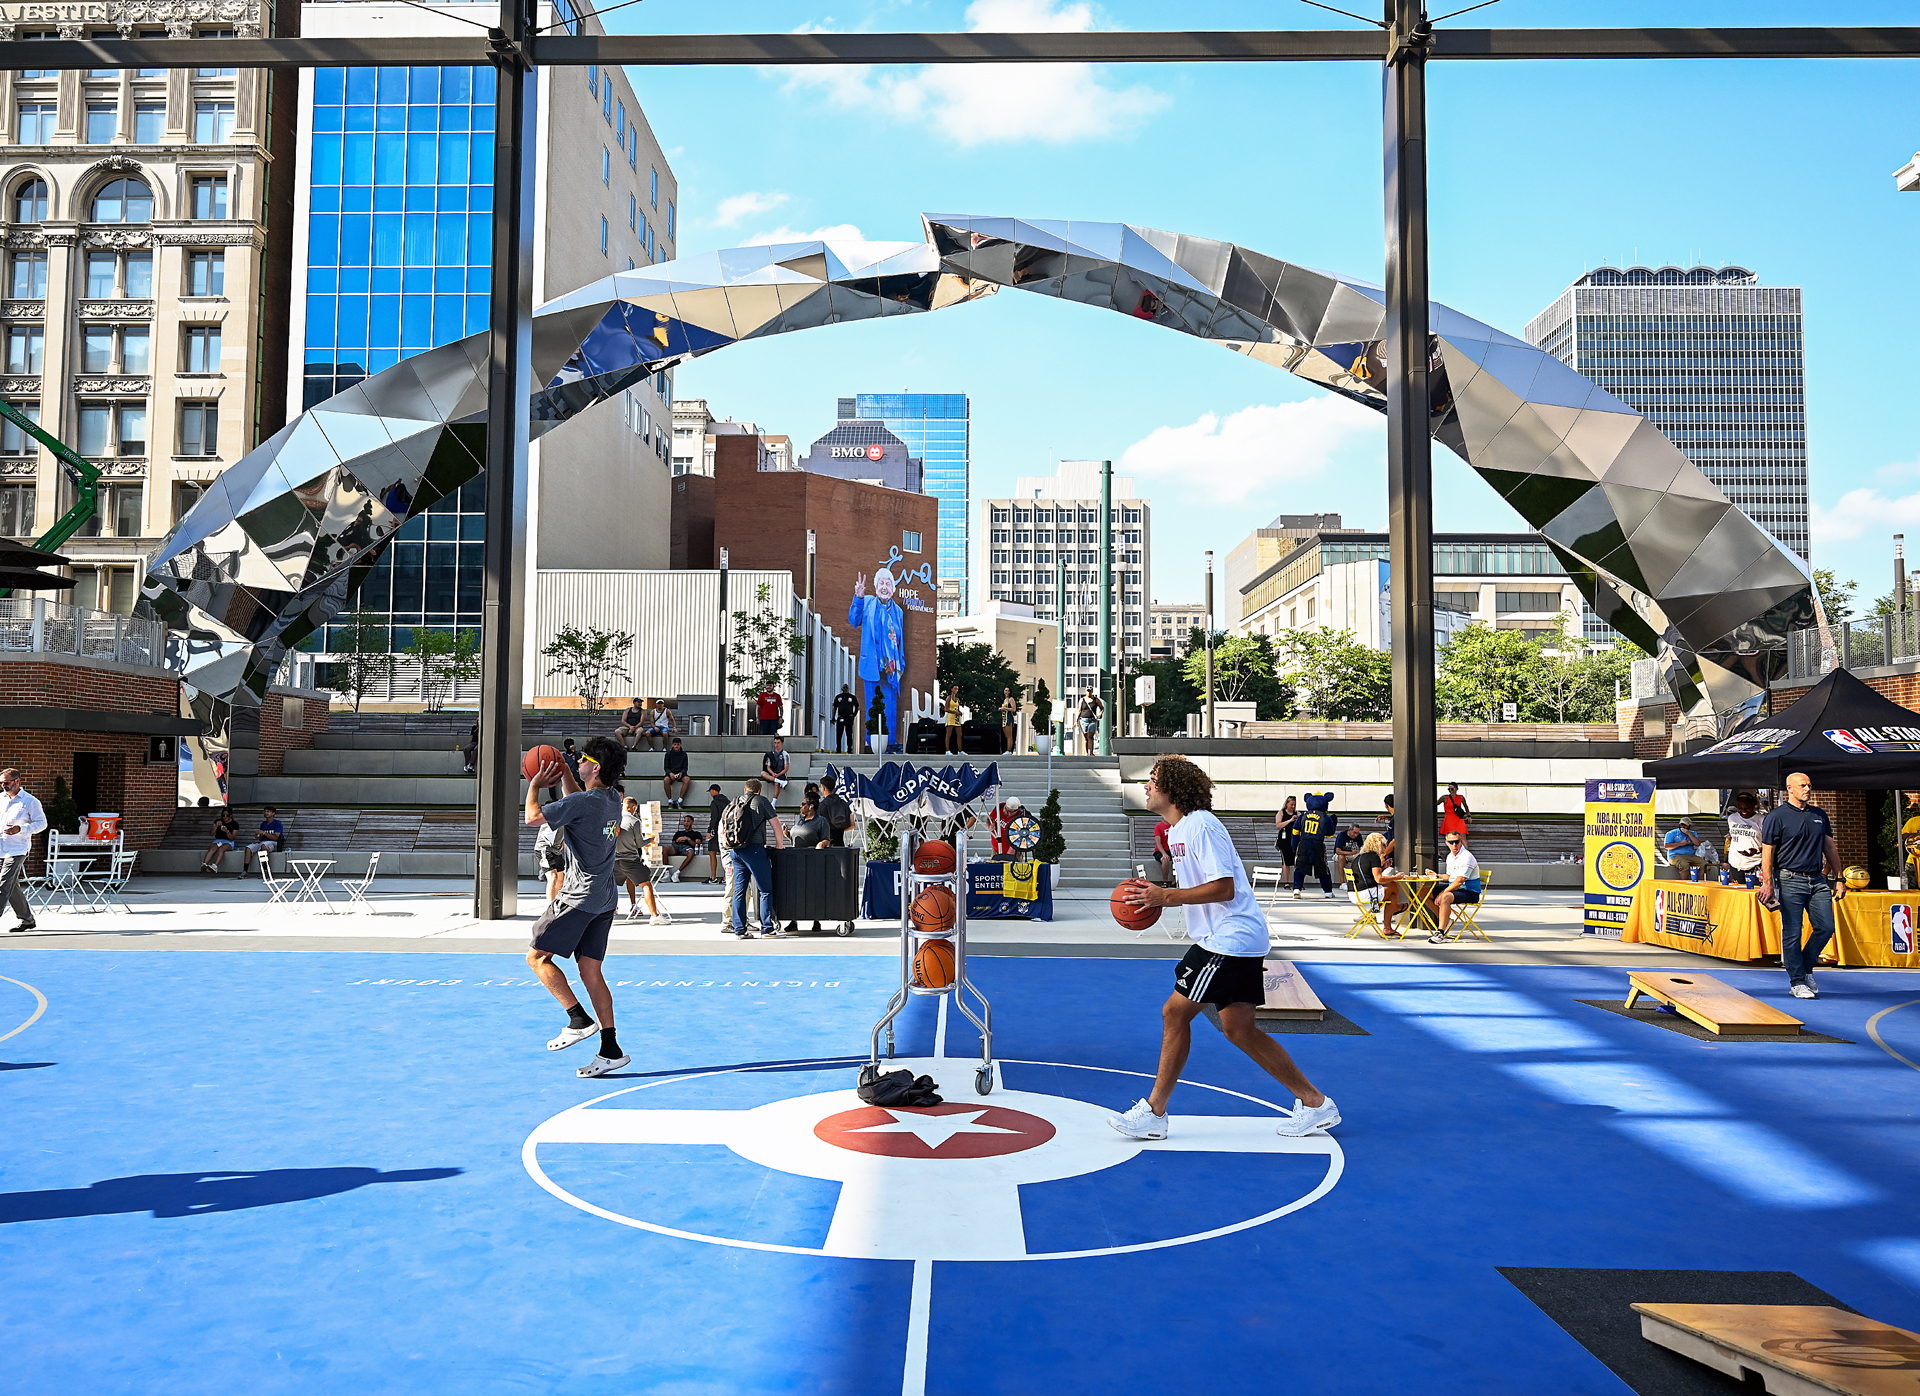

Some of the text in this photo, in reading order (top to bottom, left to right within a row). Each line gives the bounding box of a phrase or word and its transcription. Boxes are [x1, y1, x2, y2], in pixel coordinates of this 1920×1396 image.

[831, 446, 866, 458] BMO
[879, 545, 937, 591] Eva
[898, 587, 920, 600] HOPE
[101, 821, 110, 829] G
[1596, 812, 1643, 825] NBA ALL-STAR
[1304, 819, 1320, 834] 00
[1586, 824, 1653, 838] REWARDS PROGRAM
[1679, 920, 1696, 934] INDY
[1894, 942, 1906, 951] NBA
[1182, 966, 1193, 978] 7
